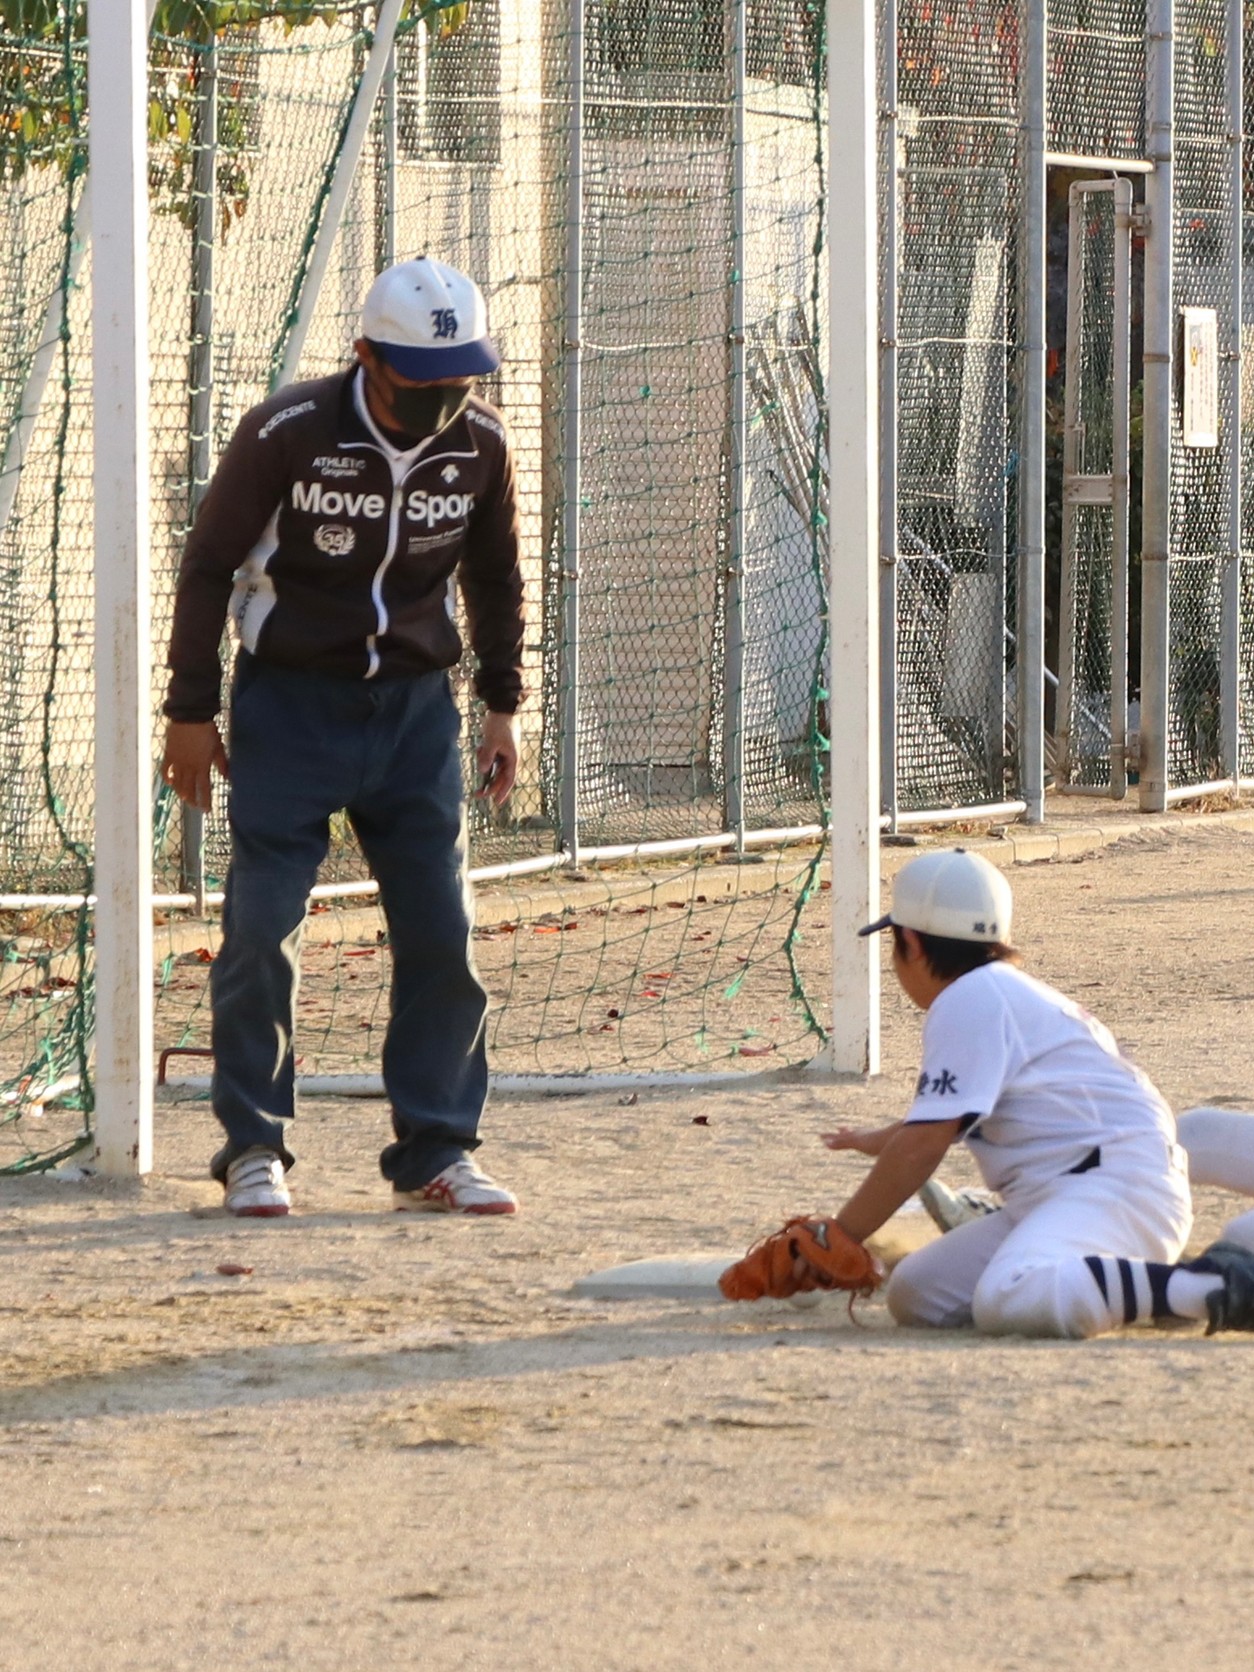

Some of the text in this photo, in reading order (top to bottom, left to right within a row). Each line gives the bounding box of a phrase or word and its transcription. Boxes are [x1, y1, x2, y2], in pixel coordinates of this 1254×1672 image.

[265, 400, 317, 432] DESCENTE
[311, 456, 367, 470] ATHLETIC
[291, 481, 476, 528] Move Spor
